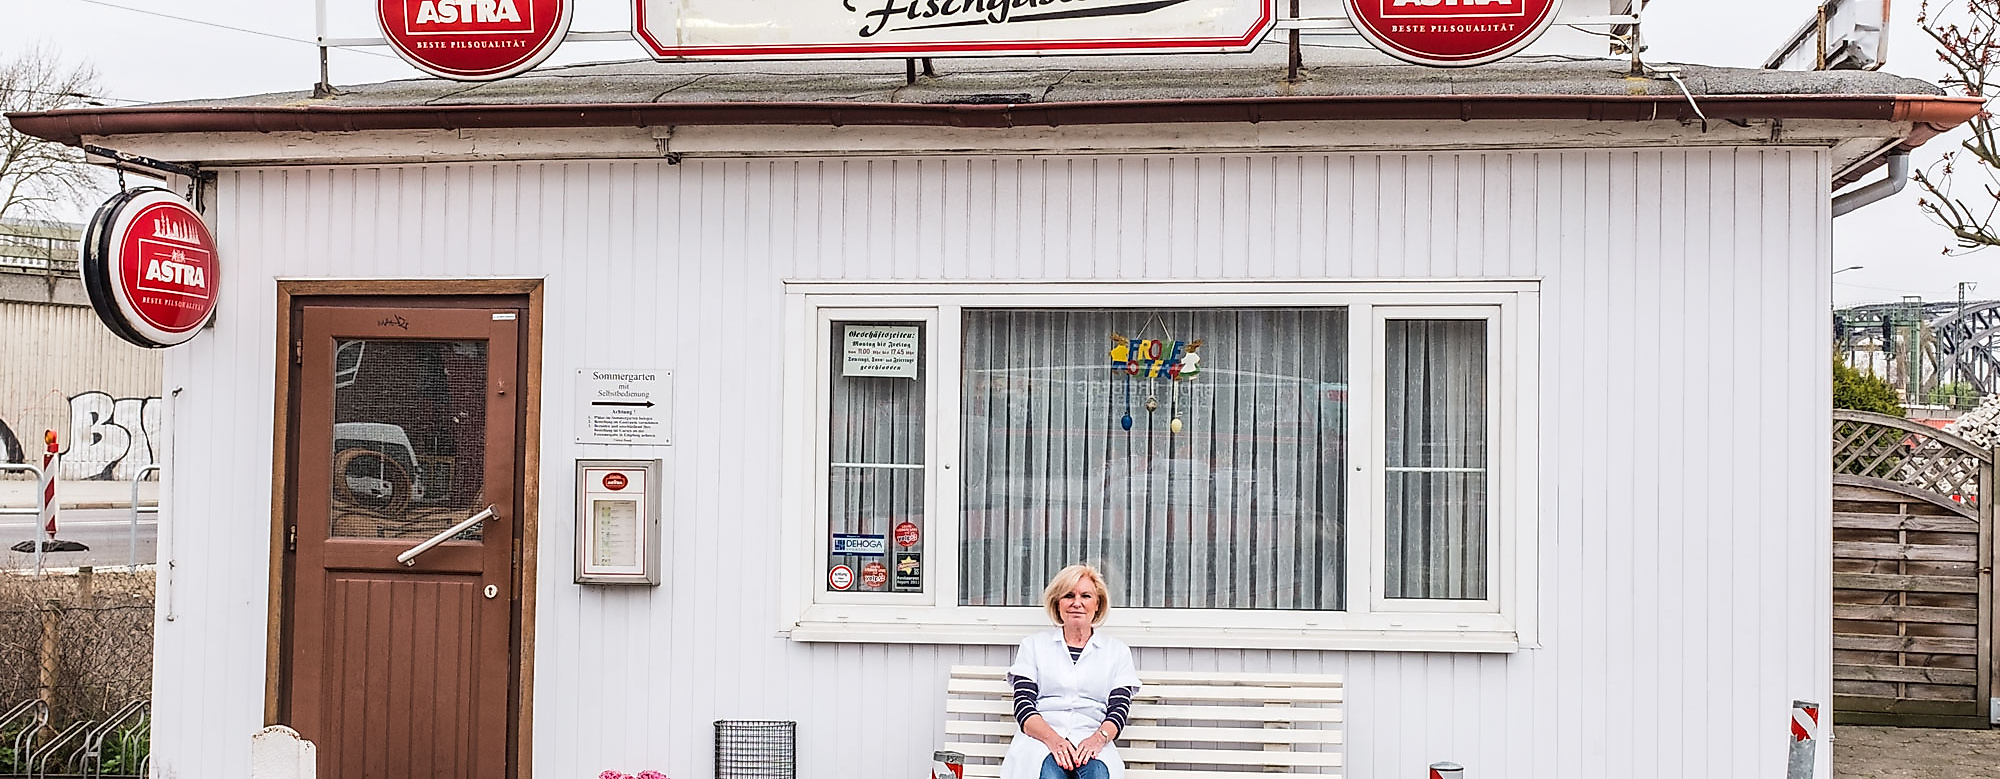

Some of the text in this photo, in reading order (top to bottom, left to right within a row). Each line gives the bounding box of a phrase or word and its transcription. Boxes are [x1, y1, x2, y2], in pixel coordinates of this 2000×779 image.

[416, 0, 521, 23] ASTRA
[1431, 23, 1515, 32] PILSQUALITÄT
[416, 40, 526, 49] BESTE PILSQUALITÄT
[145, 259, 206, 289] ASTRA
[142, 296, 162, 305] BESTE
[592, 371, 656, 382] Sommergarten
[598, 389, 650, 399] Selbstbedienung
[846, 540, 882, 548] DEHOGA
